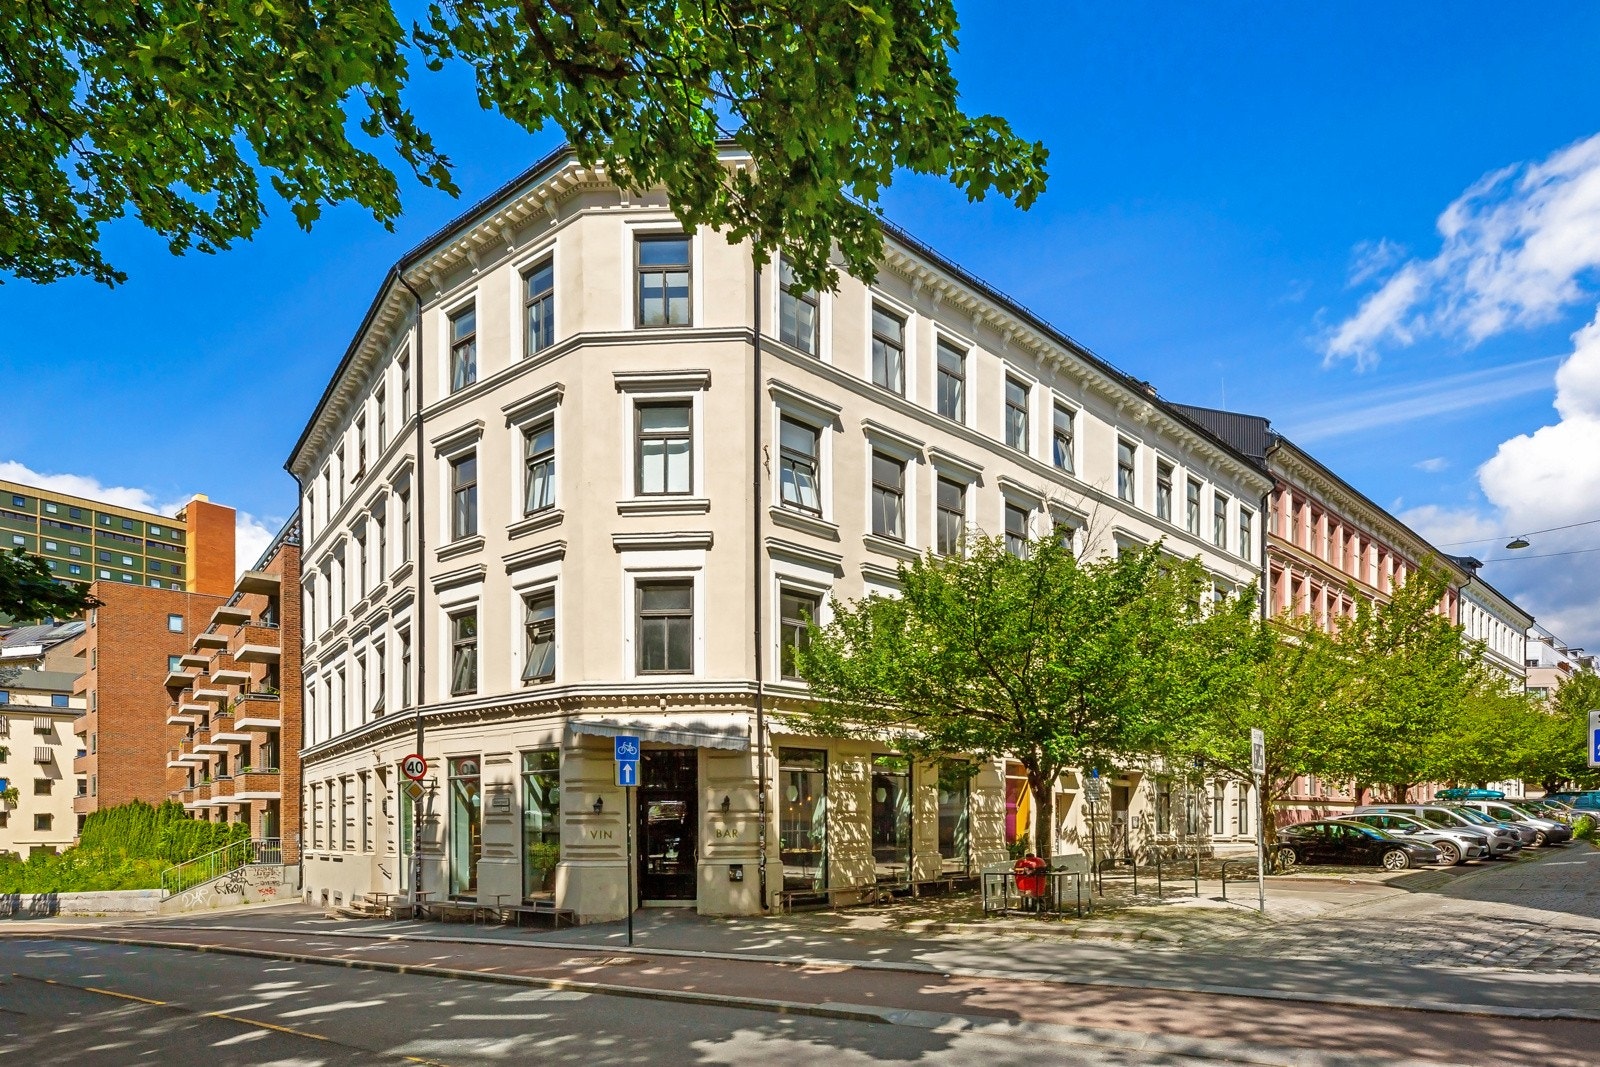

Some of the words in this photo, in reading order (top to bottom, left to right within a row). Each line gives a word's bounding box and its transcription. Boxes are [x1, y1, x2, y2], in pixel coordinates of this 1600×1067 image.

[407, 761, 423, 774] 40
[590, 830, 613, 839] VIN
[716, 829, 739, 838] BAR
